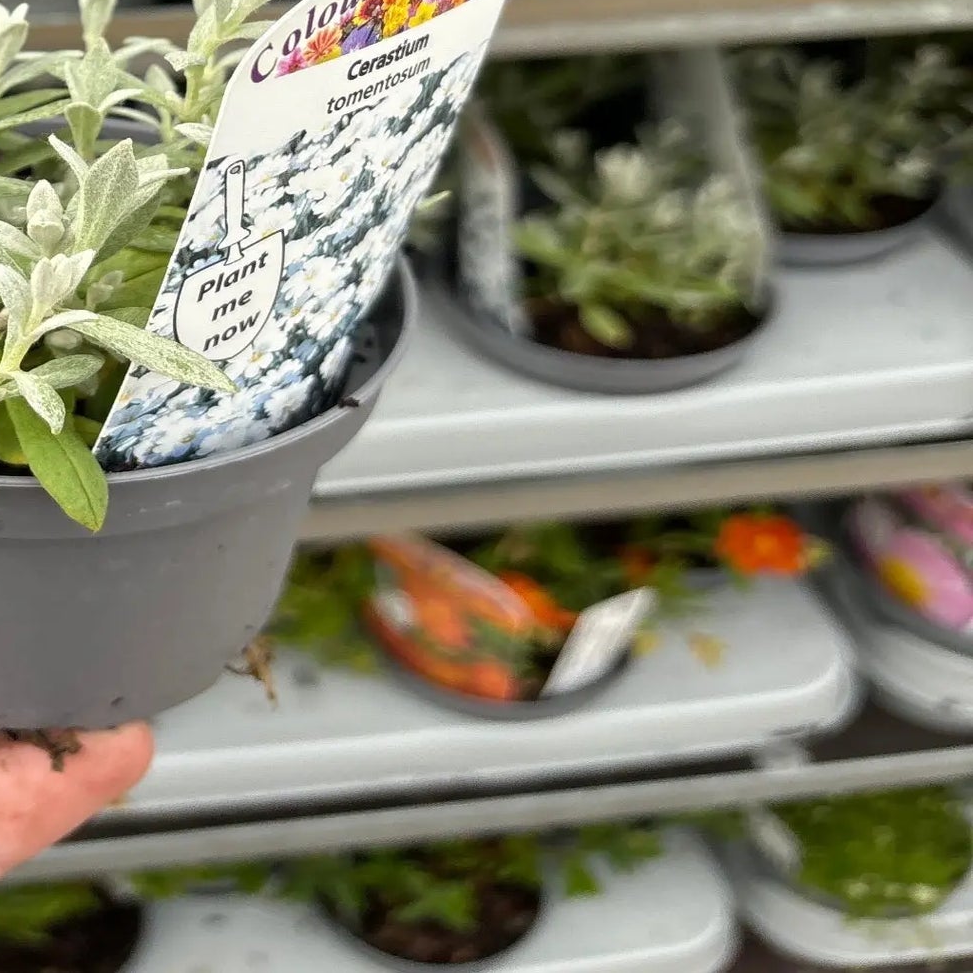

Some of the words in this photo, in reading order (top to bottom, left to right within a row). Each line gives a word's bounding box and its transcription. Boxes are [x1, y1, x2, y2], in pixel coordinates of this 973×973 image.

[347, 34, 429, 81] Cerastium
[327, 56, 430, 115] tomentosum
[197, 250, 268, 302] Plant
[211, 289, 253, 322] me
[202, 311, 261, 352] now
